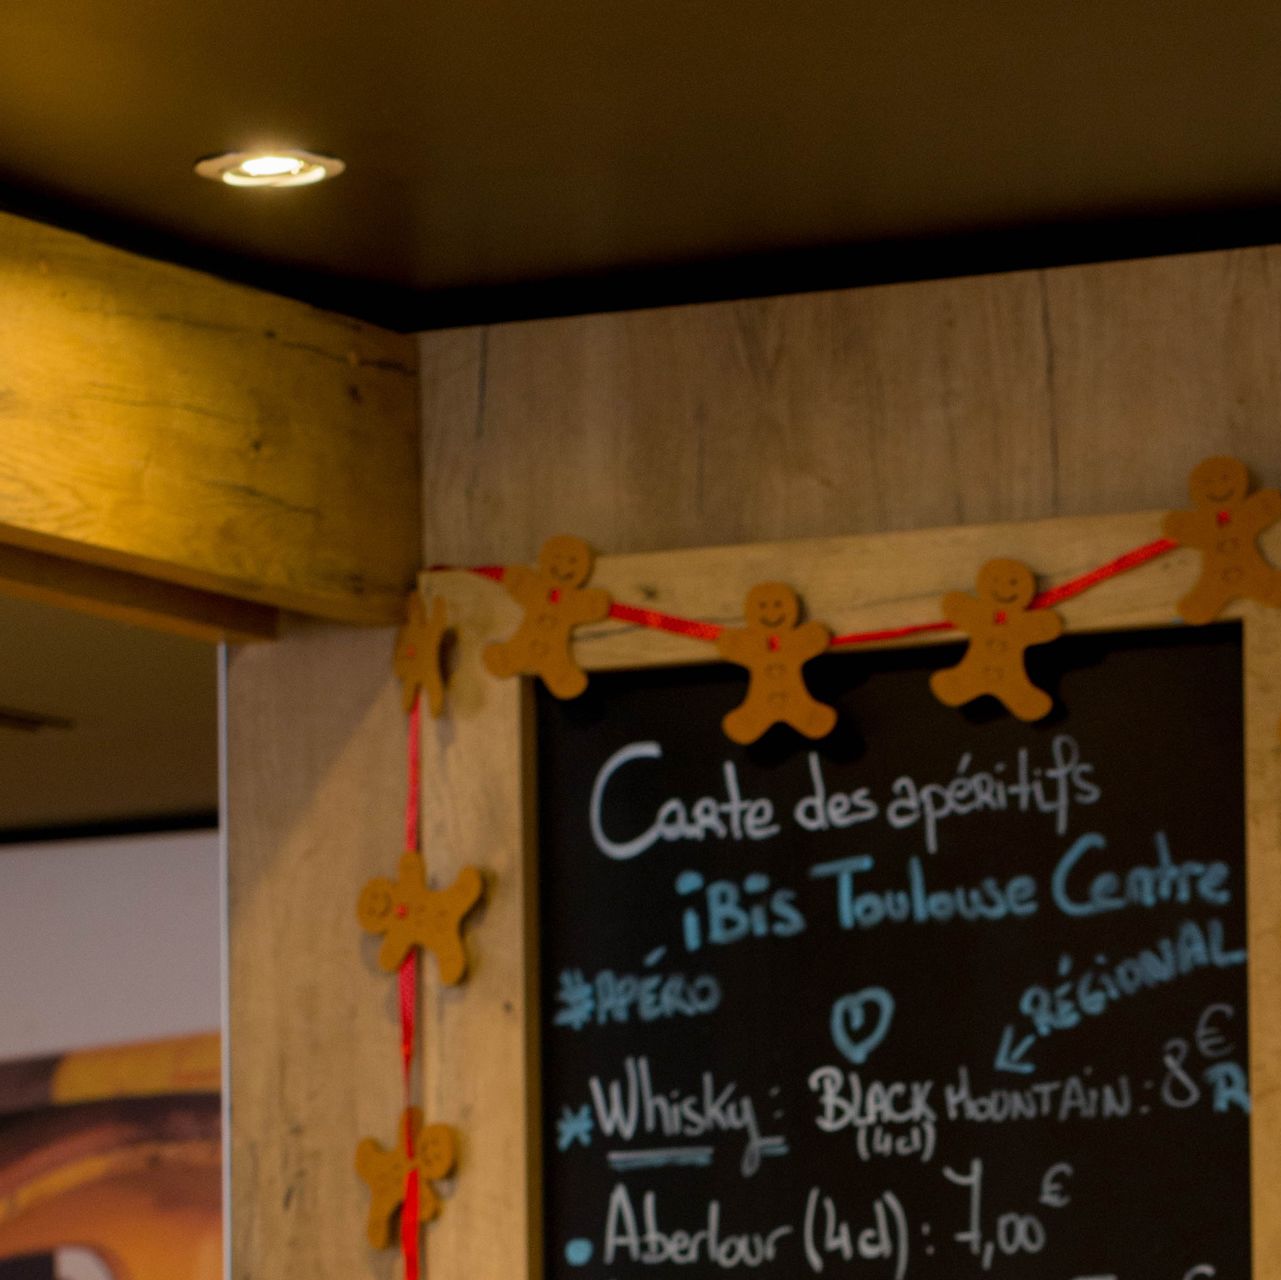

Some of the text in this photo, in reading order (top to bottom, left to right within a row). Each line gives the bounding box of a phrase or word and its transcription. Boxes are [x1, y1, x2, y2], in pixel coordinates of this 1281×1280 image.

[589, 735, 1100, 860] Carte des apéritifs
[810, 854, 1039, 930] Toulouse
[1051, 832, 1231, 917] Centre
[602, 1182, 793, 1268] Aberlour
